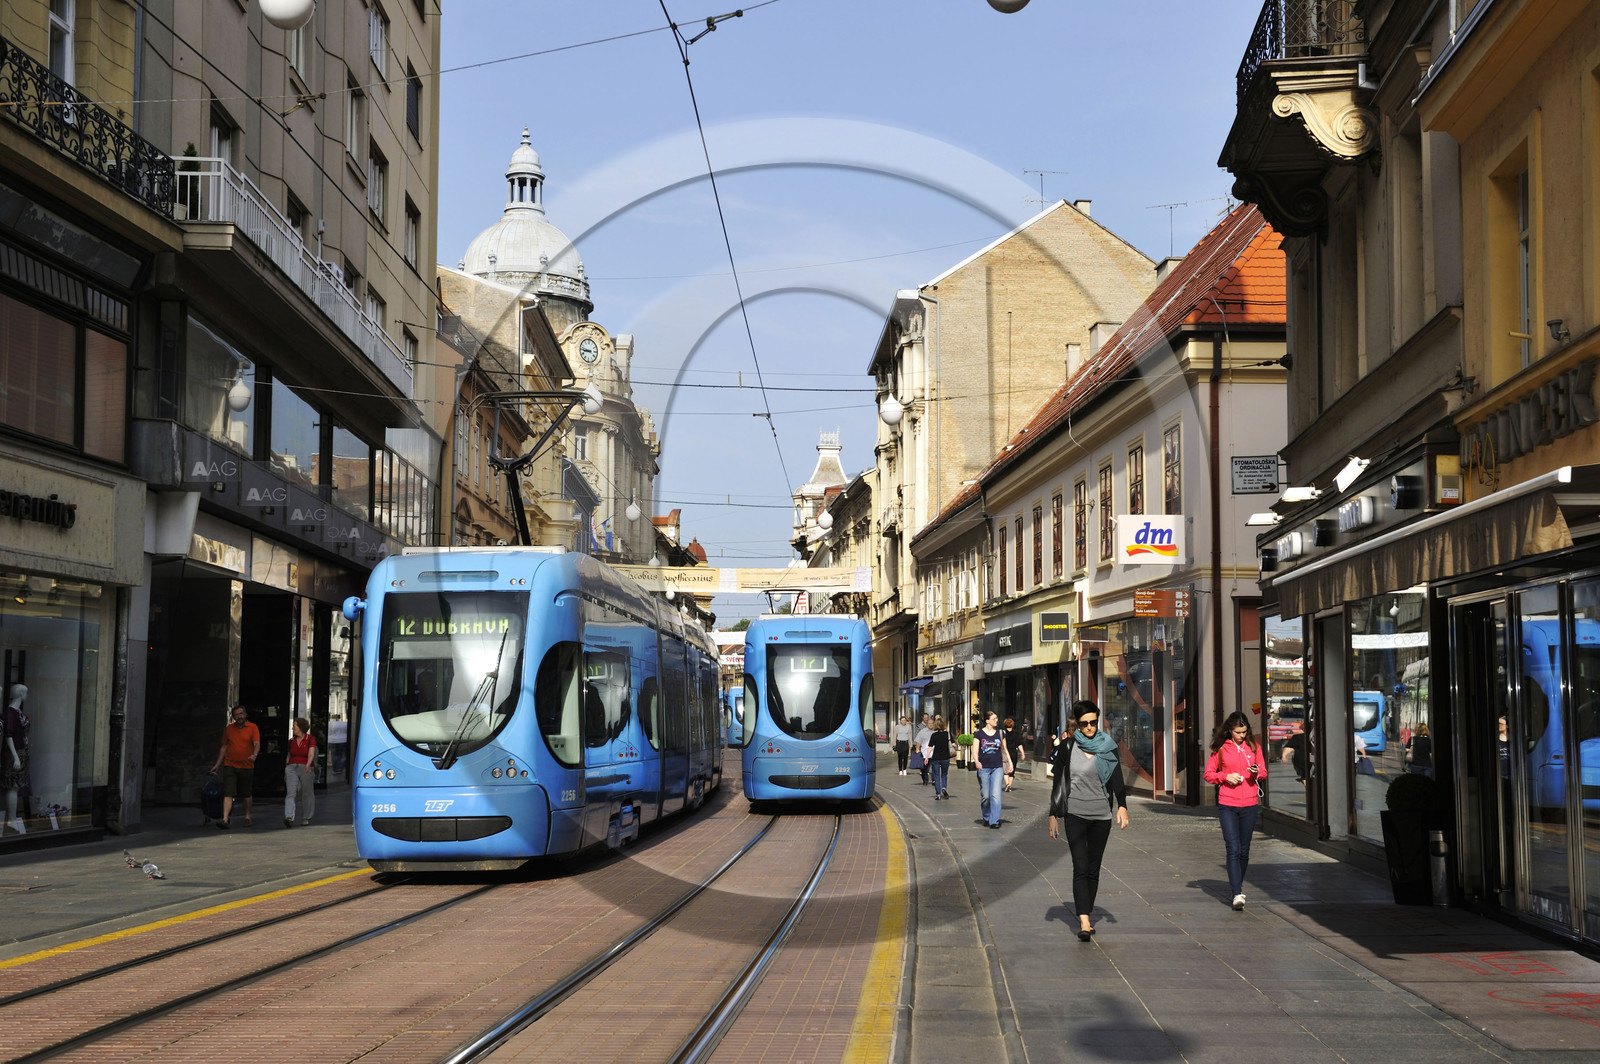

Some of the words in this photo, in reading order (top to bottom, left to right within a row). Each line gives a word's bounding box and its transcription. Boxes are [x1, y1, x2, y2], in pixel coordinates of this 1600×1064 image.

[191, 460, 237, 477] AAG
[246, 487, 287, 502] AAG
[290, 508, 327, 521] AAG
[1134, 521, 1173, 545] dm
[397, 617, 416, 635] 12
[561, 789, 576, 801] 2256
[371, 803, 397, 813] 2256
[424, 799, 455, 812] ZET
